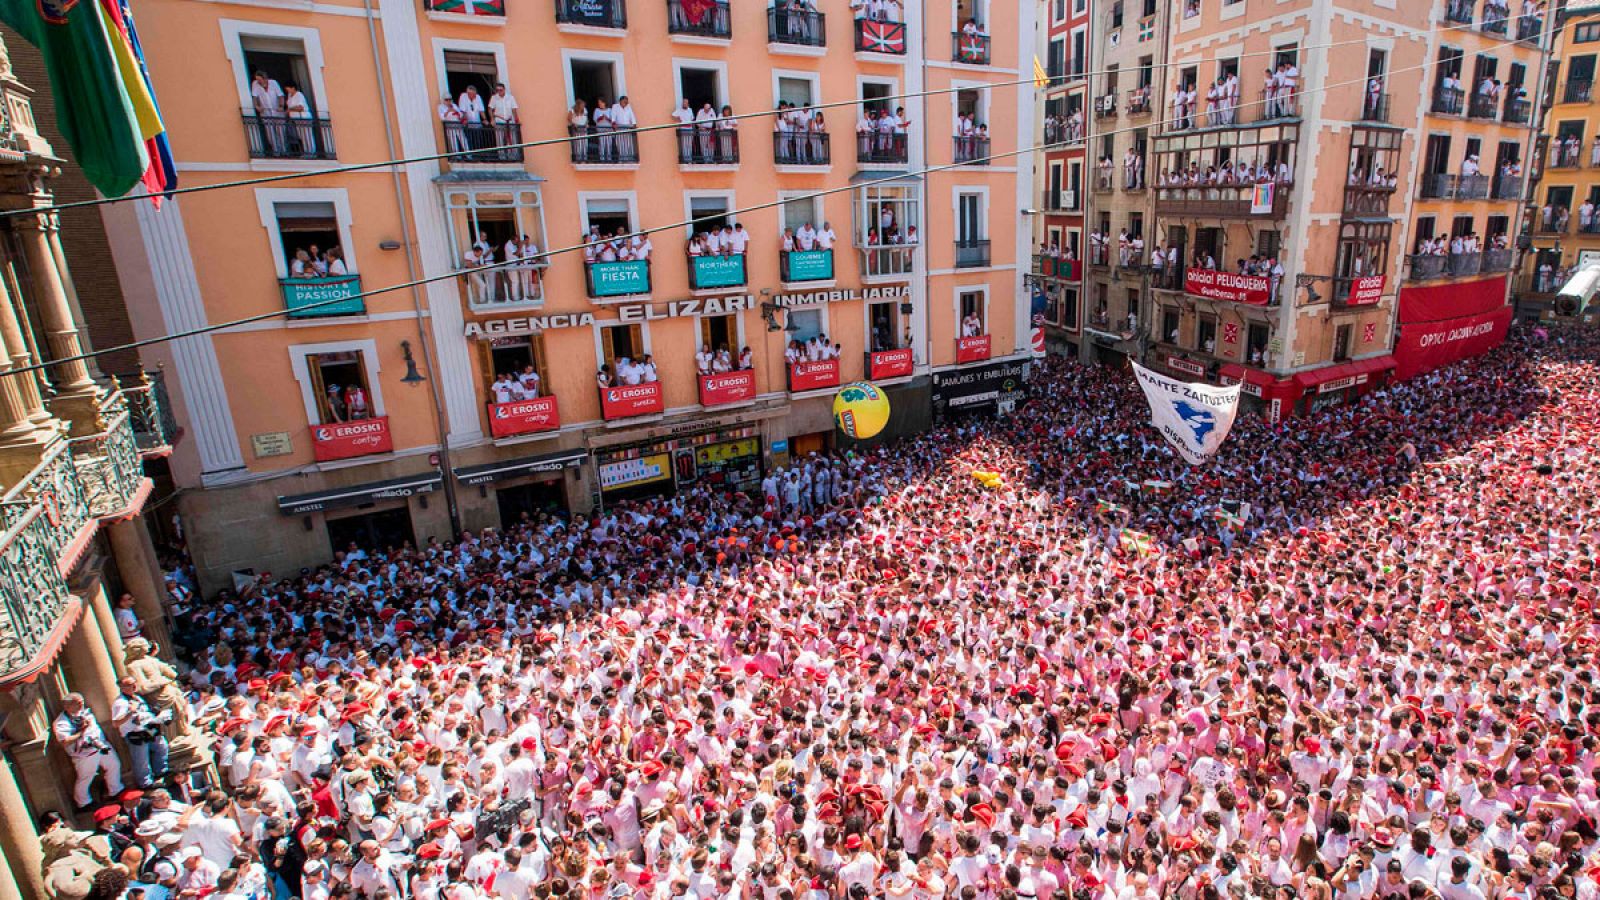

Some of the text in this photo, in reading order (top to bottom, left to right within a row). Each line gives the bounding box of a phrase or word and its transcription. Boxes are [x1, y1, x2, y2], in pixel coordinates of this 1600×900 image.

[601, 271, 640, 283] FIESTA
[296, 289, 352, 301] PASSION
[464, 286, 913, 337] AGENCIA ELIZARI INMOBILIARIA
[884, 352, 908, 363] EROSKI
[975, 371, 982, 381] Y
[719, 377, 747, 388] EROSKI
[622, 388, 655, 399] EROSKI
[511, 403, 549, 416] EROSKI
[336, 423, 381, 437] EROSKI
[352, 435, 382, 446] contigo
